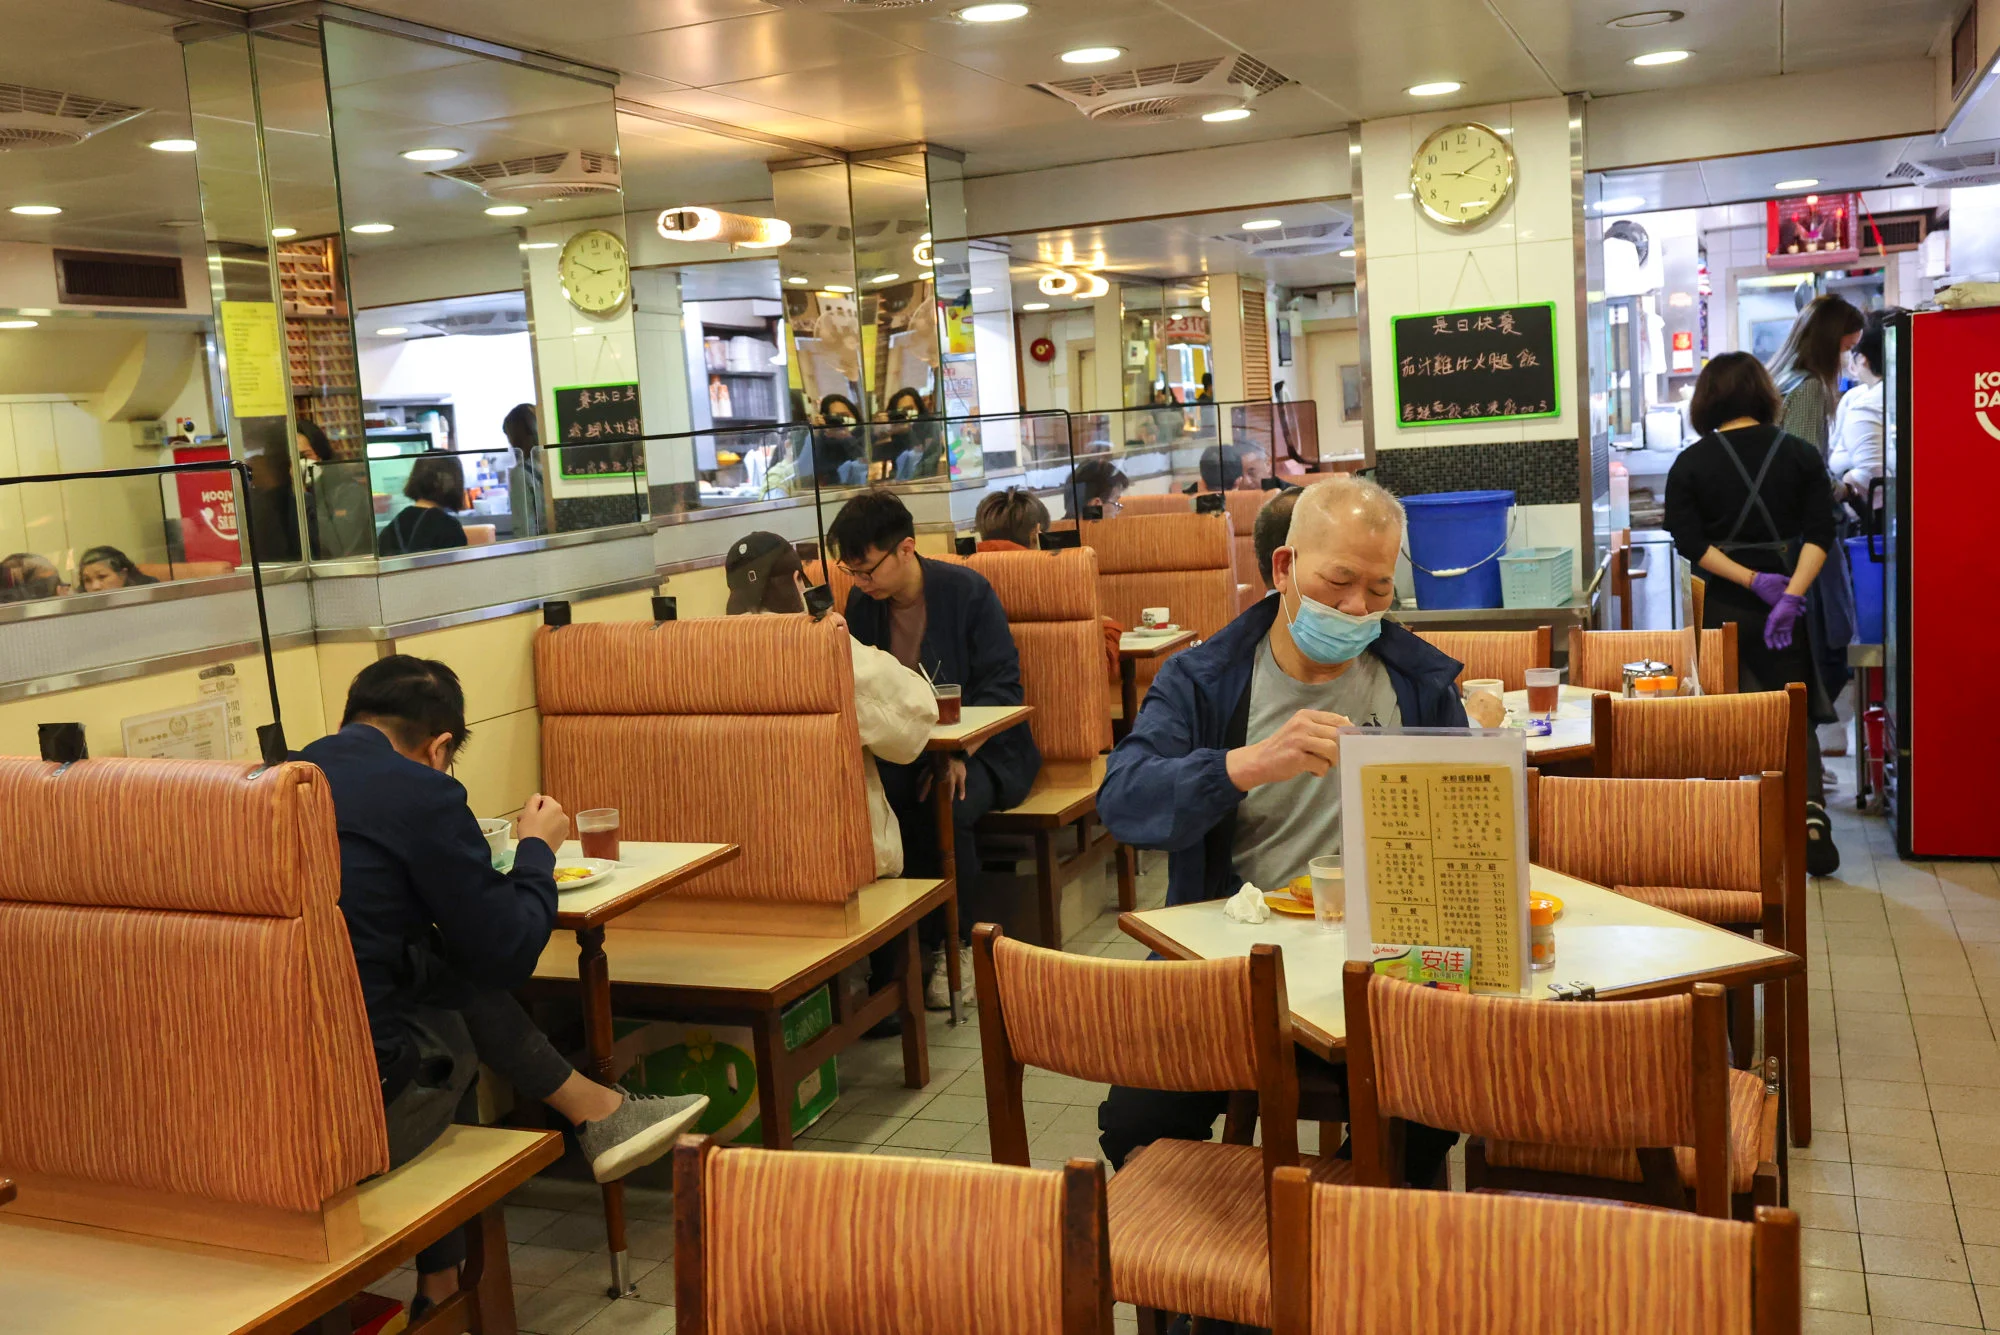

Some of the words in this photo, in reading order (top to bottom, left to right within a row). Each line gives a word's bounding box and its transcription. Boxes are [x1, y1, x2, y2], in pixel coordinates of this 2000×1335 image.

[1457, 133, 1467, 145] 12
[1440, 140, 1448, 151] 11
[1489, 148, 1496, 159] 2
[1428, 154, 1437, 165] 10
[1495, 165, 1501, 176] 3
[1425, 172, 1432, 182] 9
[1490, 183, 1497, 194] 4
[1430, 189, 1437, 200] 8
[1443, 200, 1450, 212] 7
[1432, 311, 1522, 336] 是日快餐
[1974, 372, 2000, 390] KO
[1421, 950, 1465, 972] 安佳
